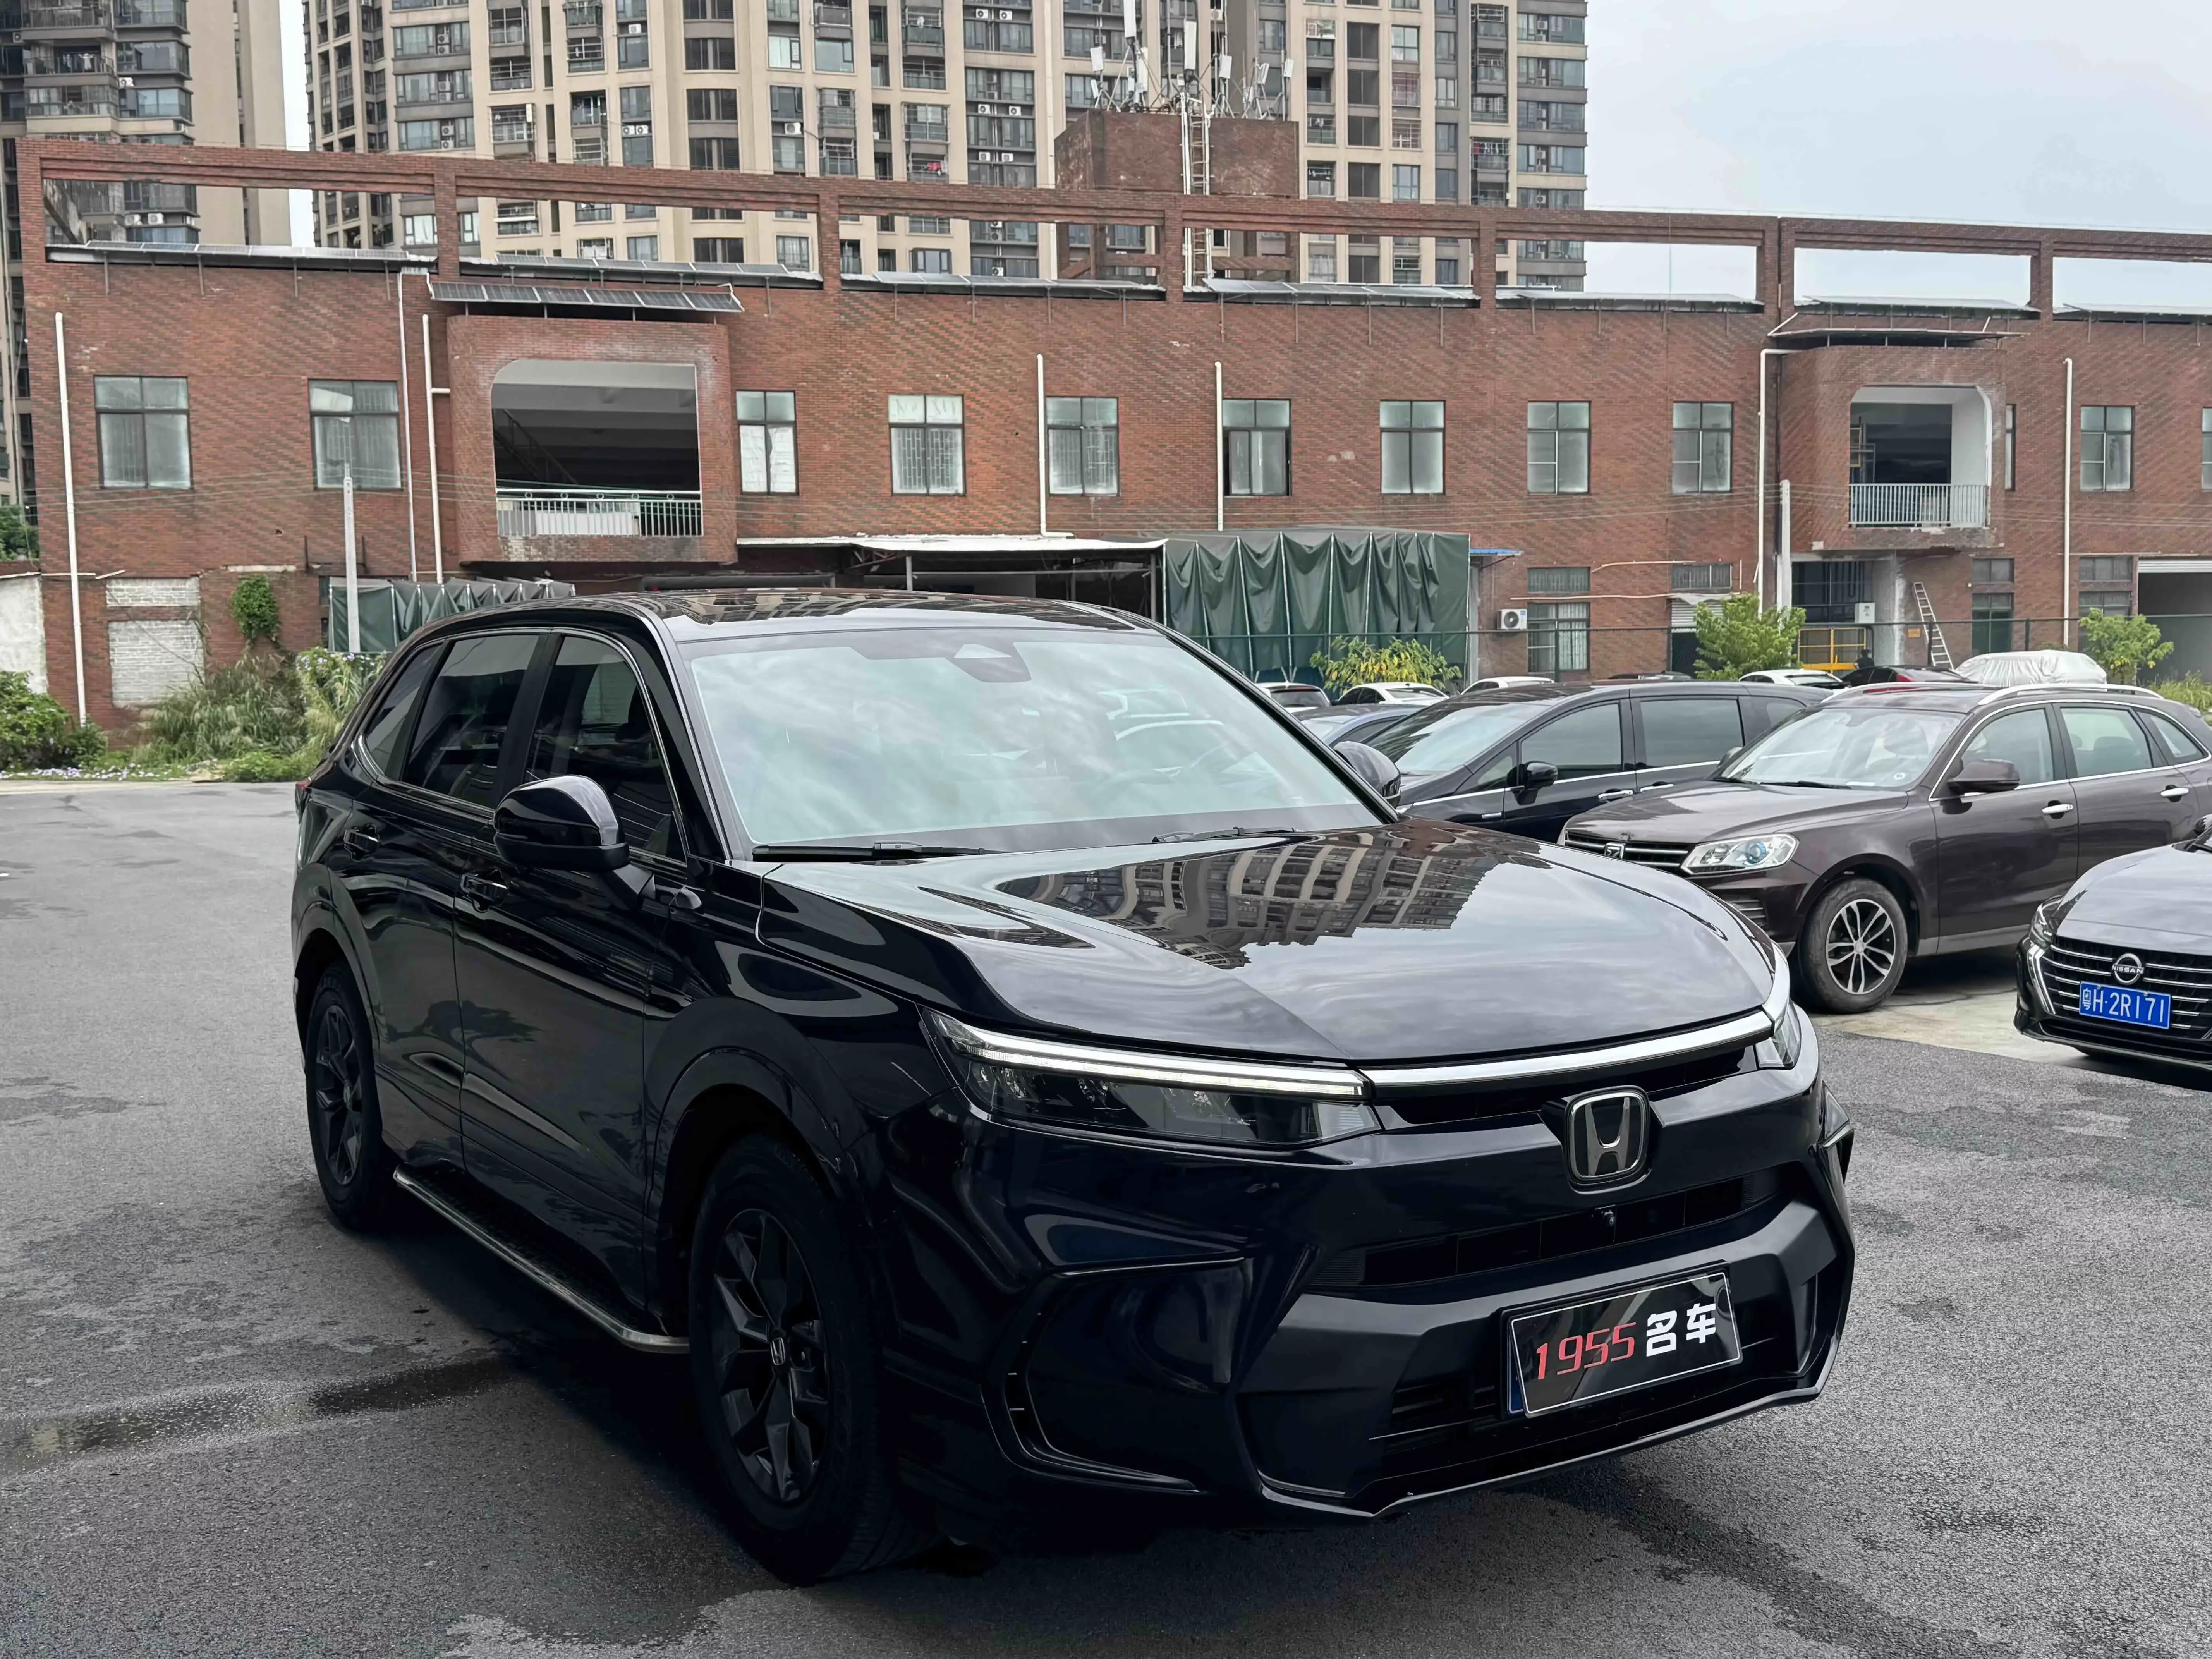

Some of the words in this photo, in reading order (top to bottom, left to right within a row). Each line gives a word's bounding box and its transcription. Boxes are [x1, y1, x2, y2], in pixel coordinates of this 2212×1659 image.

[2112, 965, 2143, 974] NISSAN
[1536, 1322, 1636, 1380] 1955
[1646, 1303, 1716, 1356] 名车
